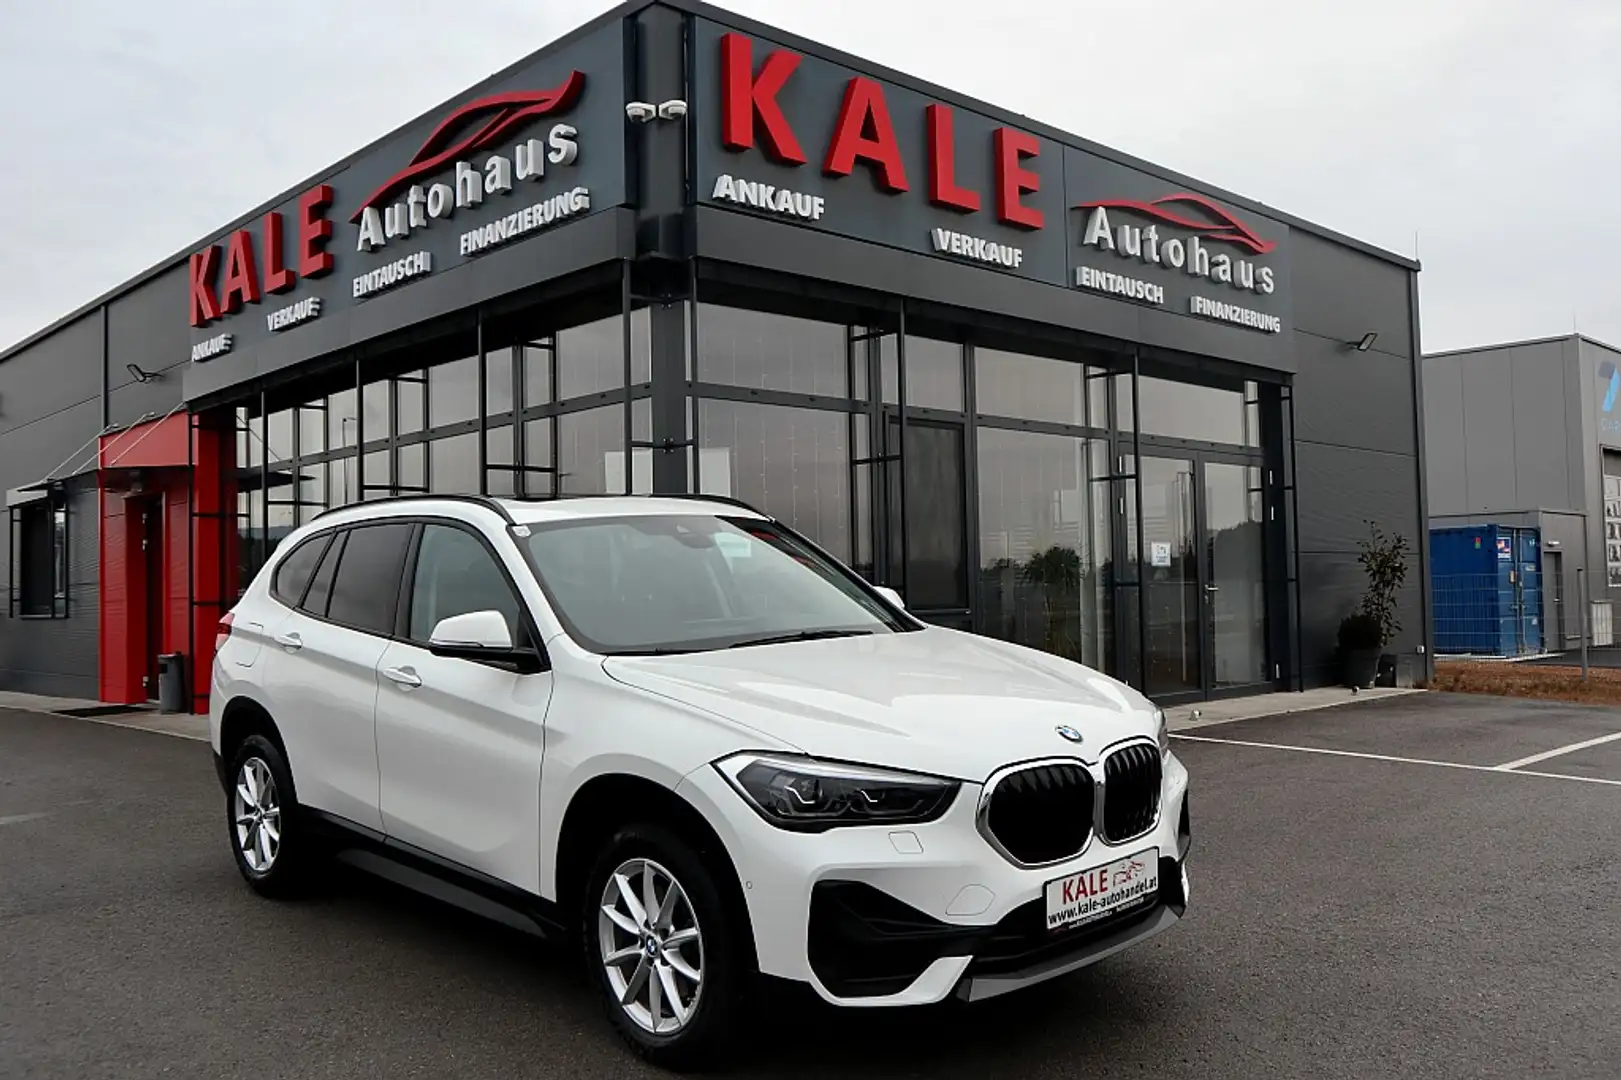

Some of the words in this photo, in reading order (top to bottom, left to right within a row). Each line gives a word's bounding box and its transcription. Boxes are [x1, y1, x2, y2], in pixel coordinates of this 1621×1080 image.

[720, 32, 1044, 230] KALE
[356, 122, 579, 252] Autohaus
[712, 174, 825, 220] ANKAUF
[460, 186, 590, 256] FINANZIERUNG
[189, 184, 334, 327] KALE
[930, 228, 1022, 268] VERKAUF
[1083, 206, 1275, 294] Autohaus
[352, 251, 431, 298] EINTAUSCH
[1075, 266, 1163, 304] EINTAUSCH
[267, 296, 321, 332] VERKAUF
[1190, 296, 1281, 333] FINANZIERUNG
[191, 333, 232, 362] ANKAUF
[1048, 876, 1157, 925] www.kale-autohandel.at
[1062, 868, 1109, 905] KALE
